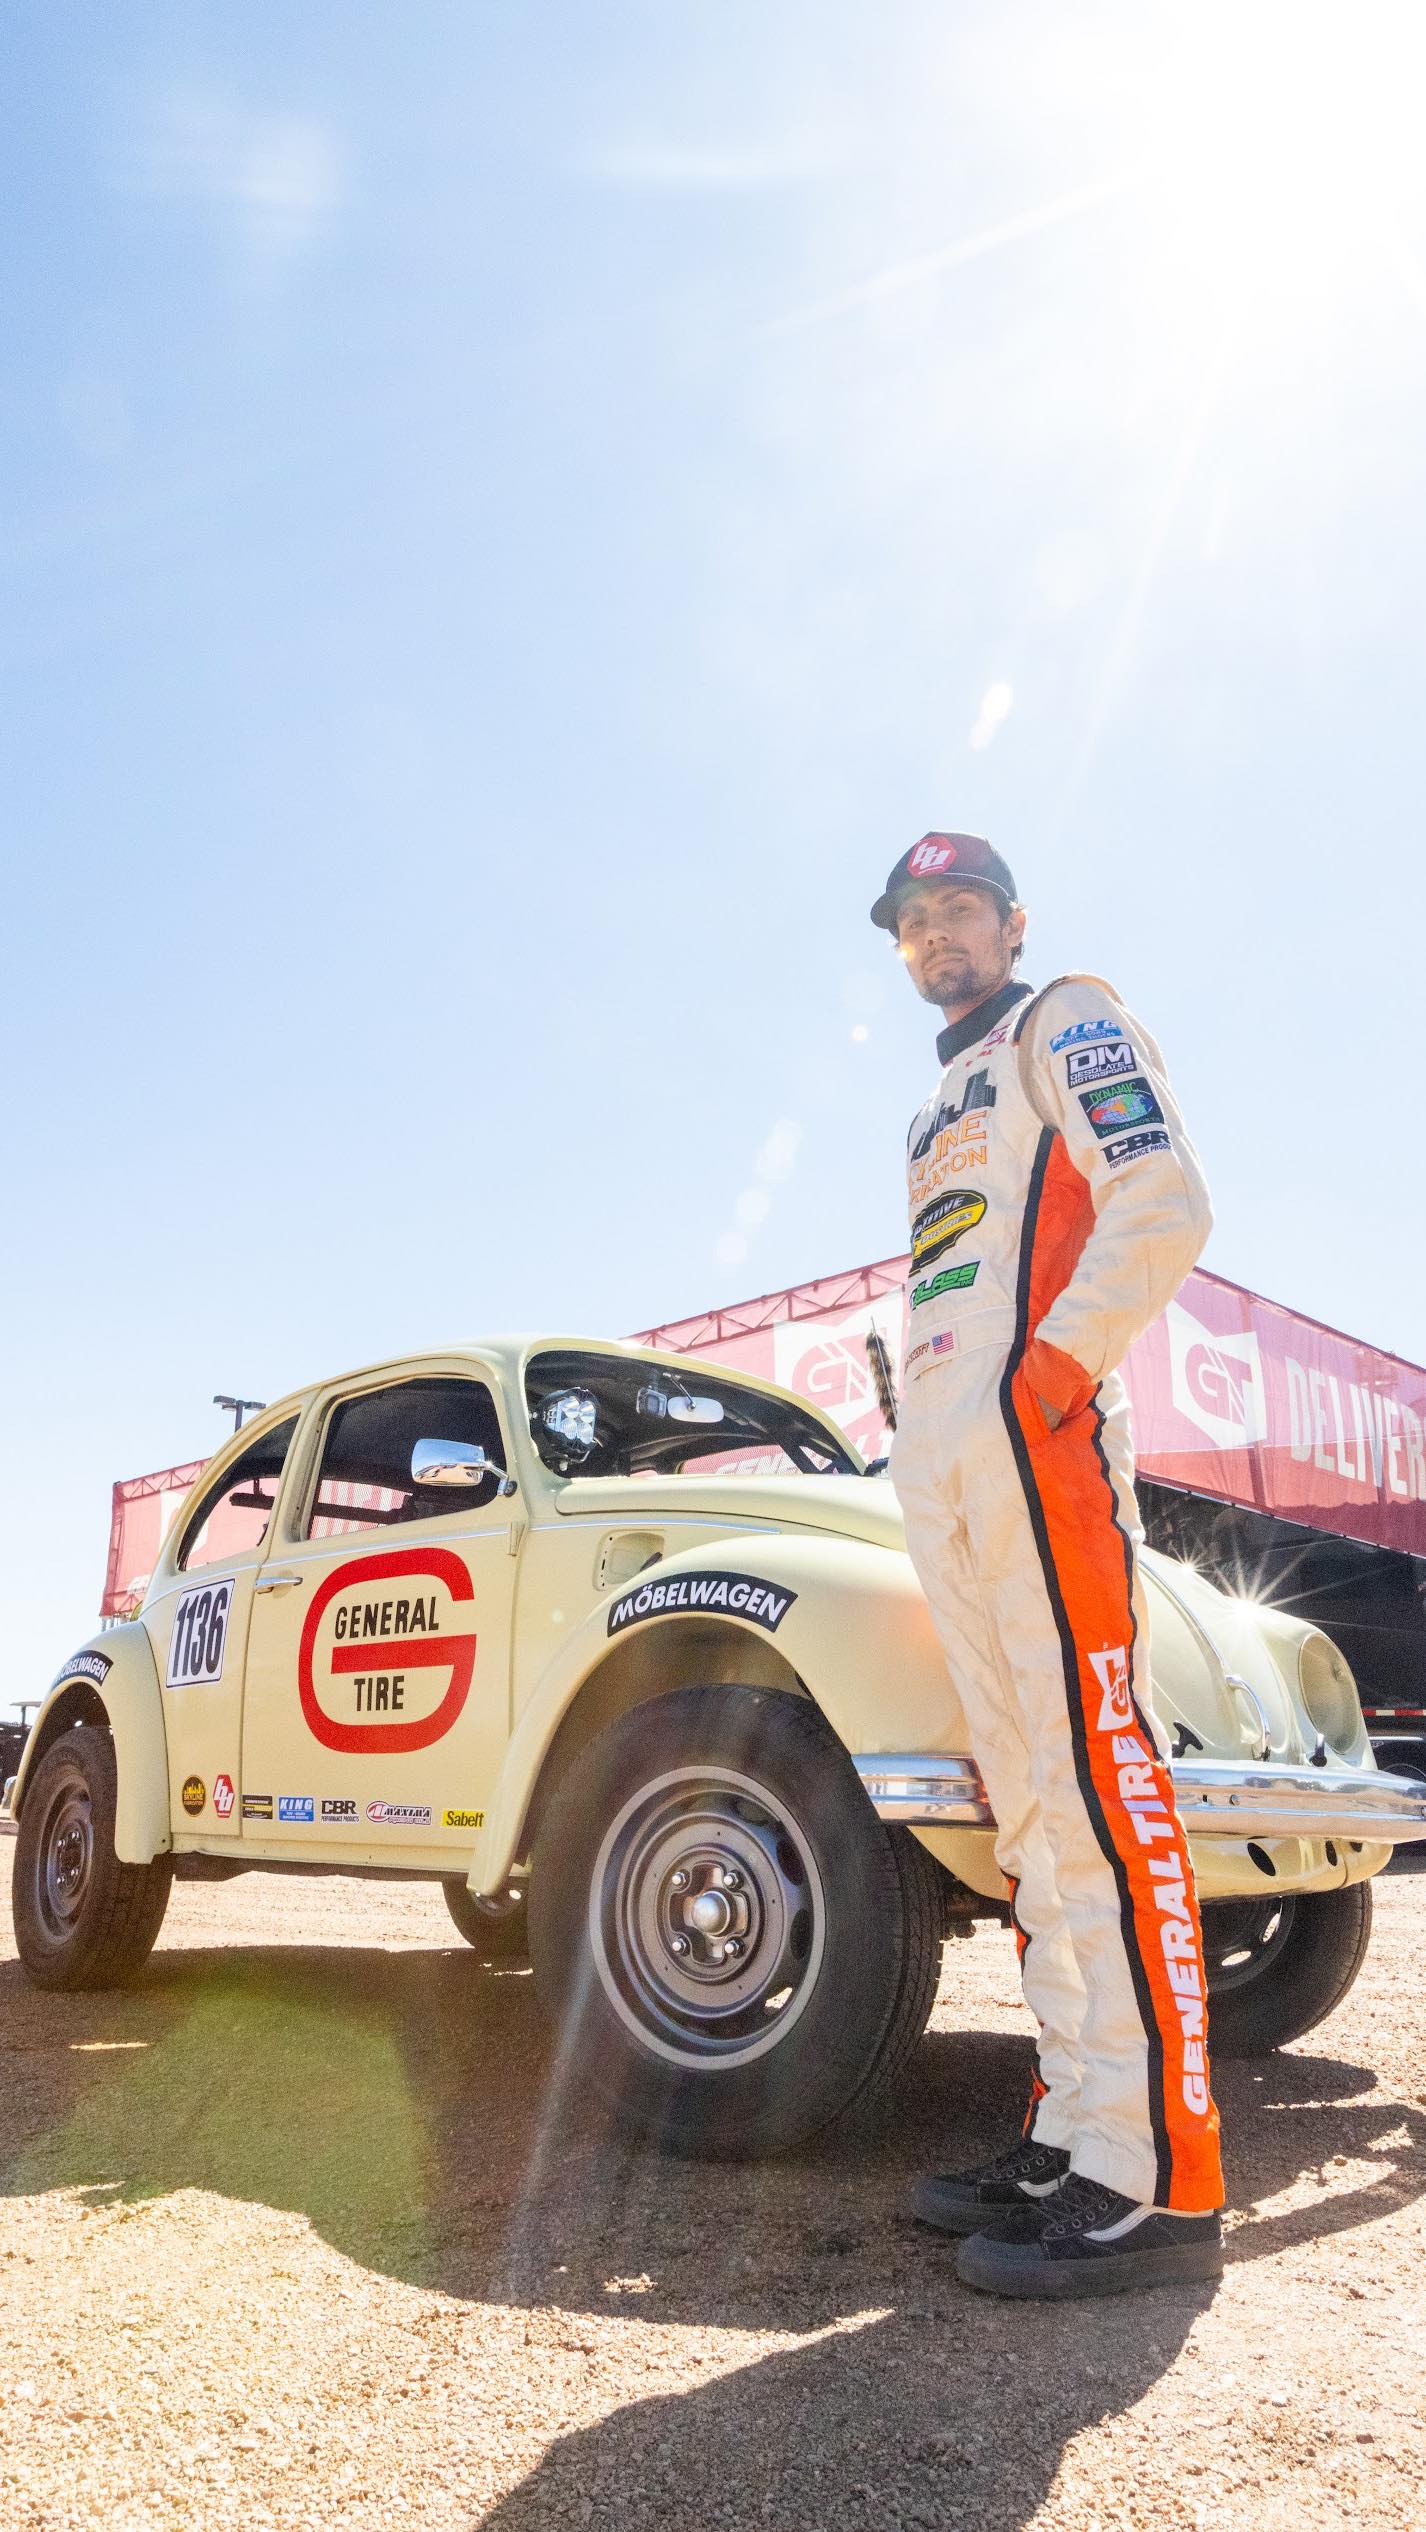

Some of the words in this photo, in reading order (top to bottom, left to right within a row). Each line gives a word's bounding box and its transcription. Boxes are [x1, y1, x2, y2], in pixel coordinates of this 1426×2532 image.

[1070, 1061, 1125, 1080] DESOLATE
[1070, 1065, 1134, 1087] MOTORSPORTS
[1089, 1082, 1137, 1104] DYNAMIC
[1100, 1131, 1170, 1163] CBR
[1108, 1147, 1150, 1170] PERFORMANCE
[611, 1580, 788, 1628] MÖBELWAGEN
[334, 1596, 440, 1640] GENERAL
[172, 1586, 229, 1678] 1136
[354, 1675, 405, 1712] TIRE
[1112, 1734, 1176, 1846] TIRE
[280, 1798, 313, 1810] KING
[321, 1800, 356, 1815] CBR
[383, 1806, 431, 1818] MAXIMA
[446, 1810, 485, 1828] Sabelt
[1148, 1850, 1208, 2116] GENERAL
